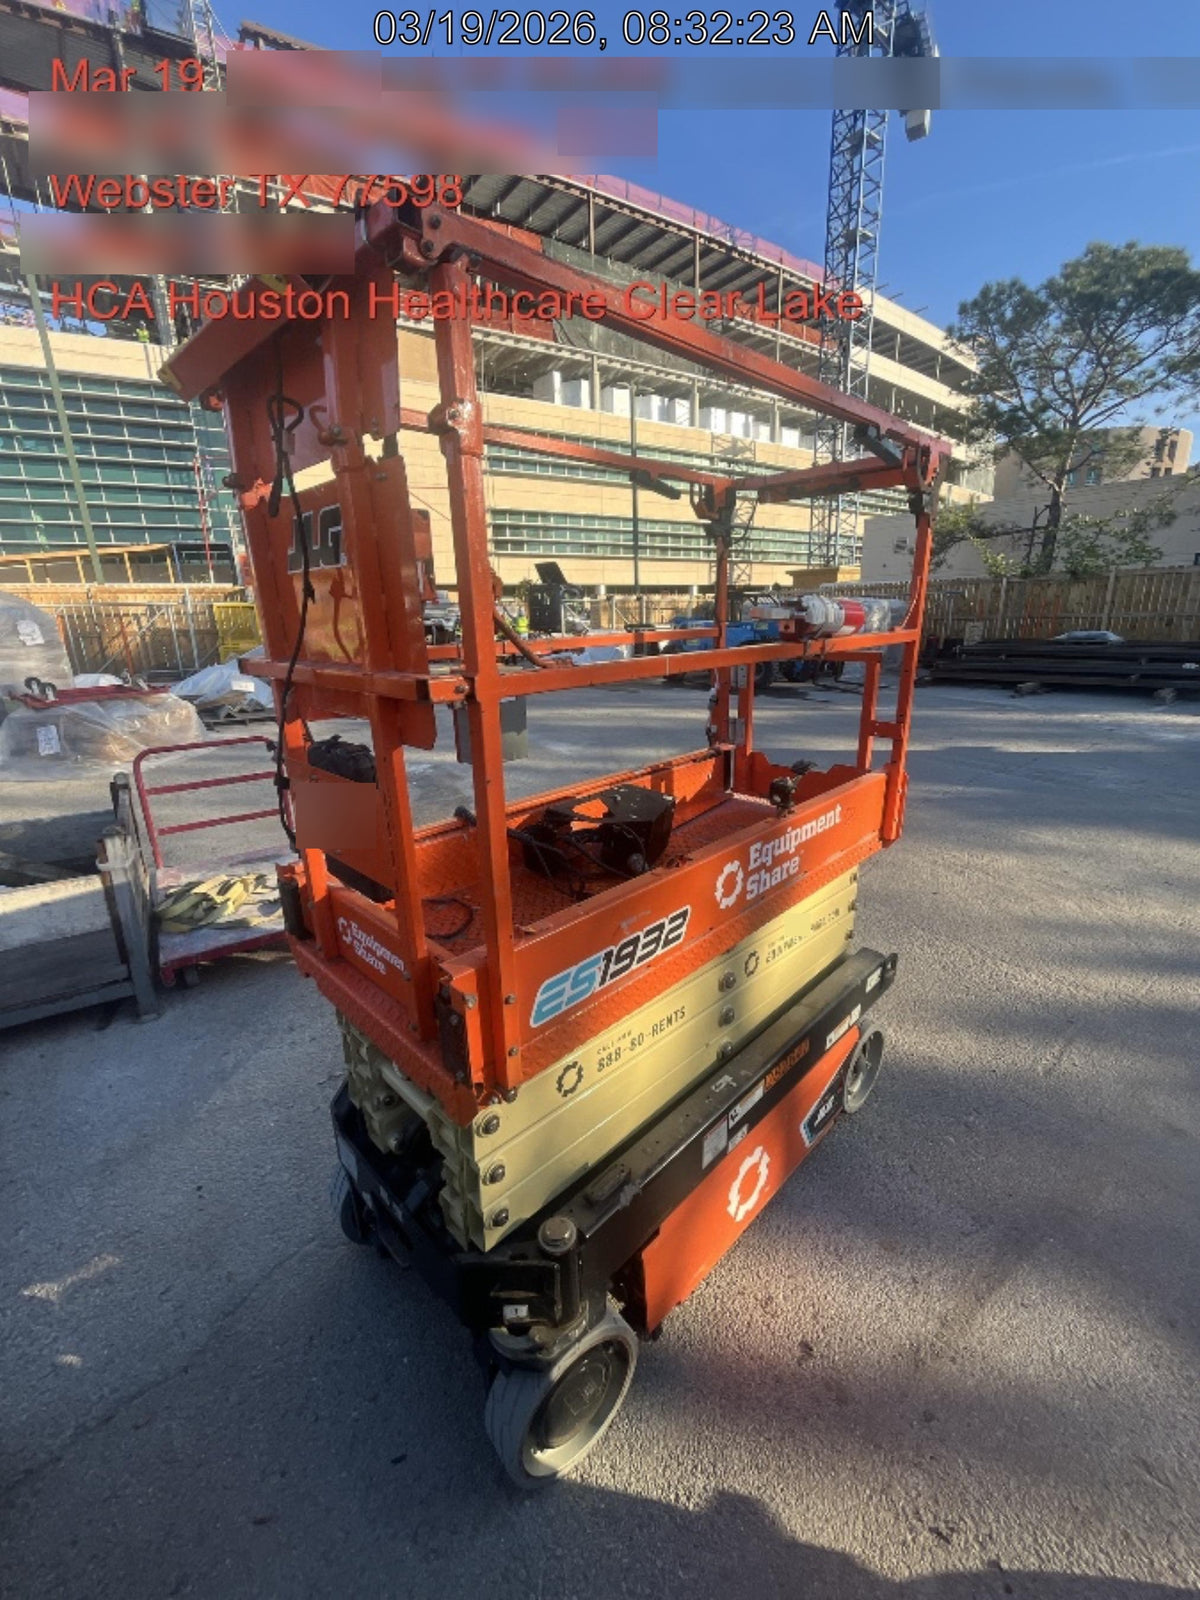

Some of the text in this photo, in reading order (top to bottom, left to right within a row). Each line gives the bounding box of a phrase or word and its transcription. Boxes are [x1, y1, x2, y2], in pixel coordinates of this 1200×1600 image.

[748, 803, 842, 872] Equipment
[746, 856, 800, 900] Share
[350, 920, 407, 973] Equipmen
[530, 905, 692, 1028] ES1932
